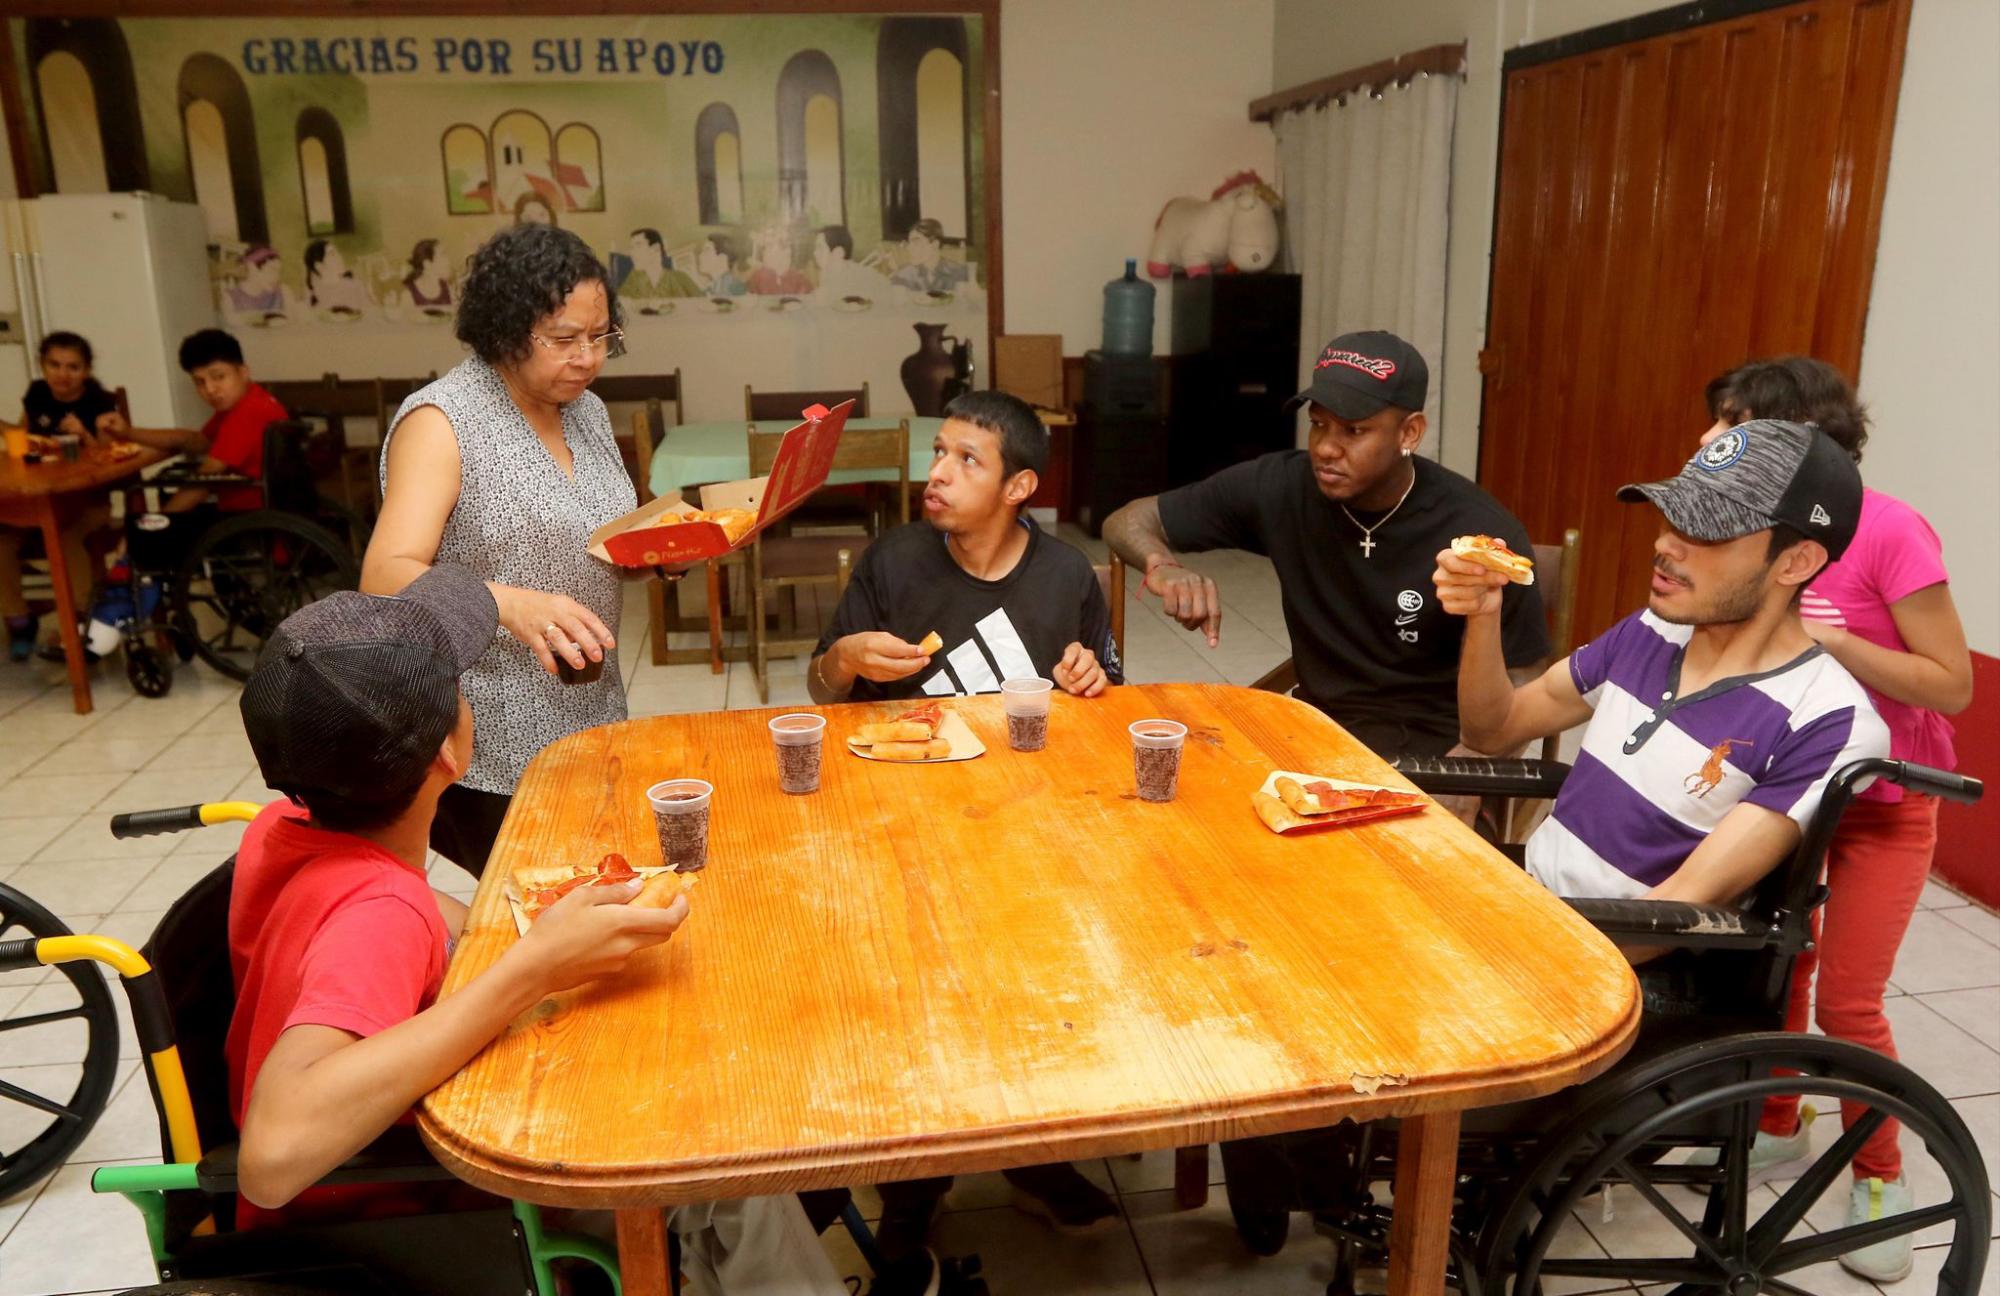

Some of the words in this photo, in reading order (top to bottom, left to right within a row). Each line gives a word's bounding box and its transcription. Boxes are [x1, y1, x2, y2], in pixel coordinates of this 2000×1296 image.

[242, 37, 417, 74] GRACIAS
[433, 37, 512, 75] POR
[533, 38, 581, 74] SU
[595, 37, 724, 77] APOYO
